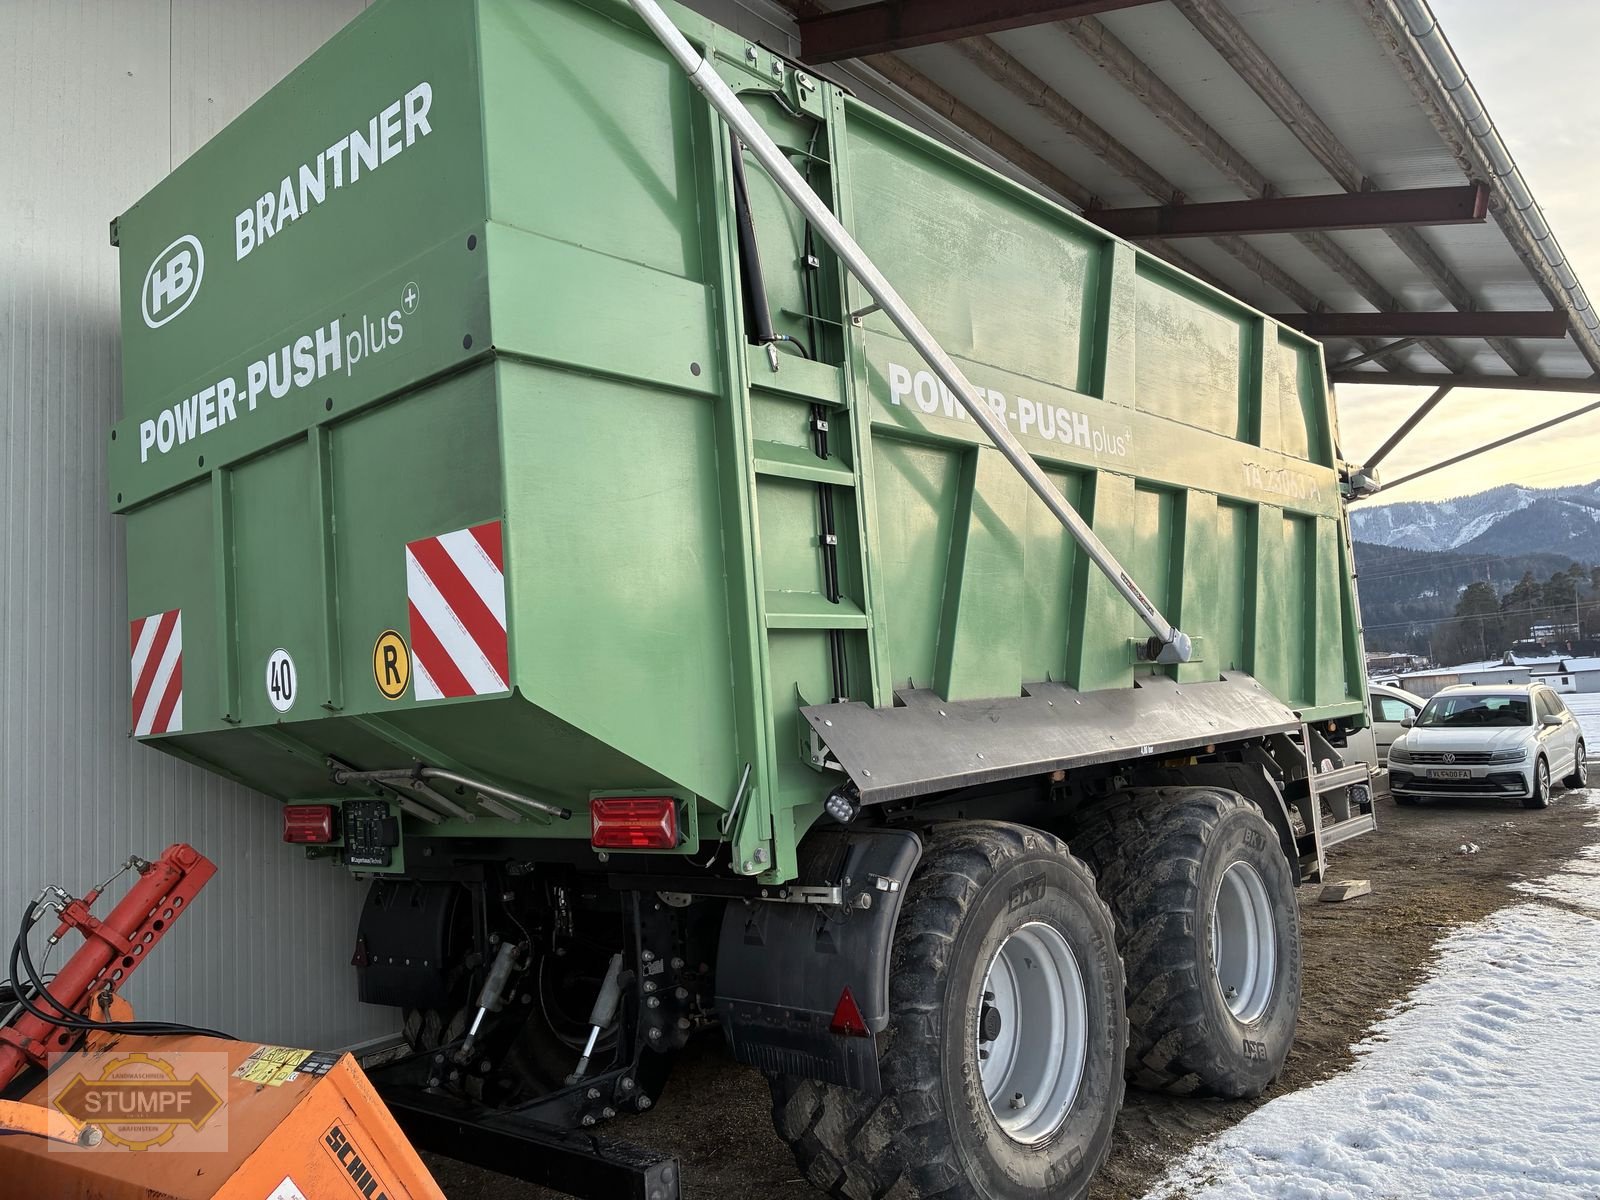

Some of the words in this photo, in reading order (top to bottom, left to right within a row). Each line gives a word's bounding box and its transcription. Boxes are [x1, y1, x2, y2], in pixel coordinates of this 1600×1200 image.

[235, 82, 432, 262] BRANTNER
[271, 659, 292, 700] 40
[383, 644, 401, 686] R
[1245, 829, 1265, 849] BKT
